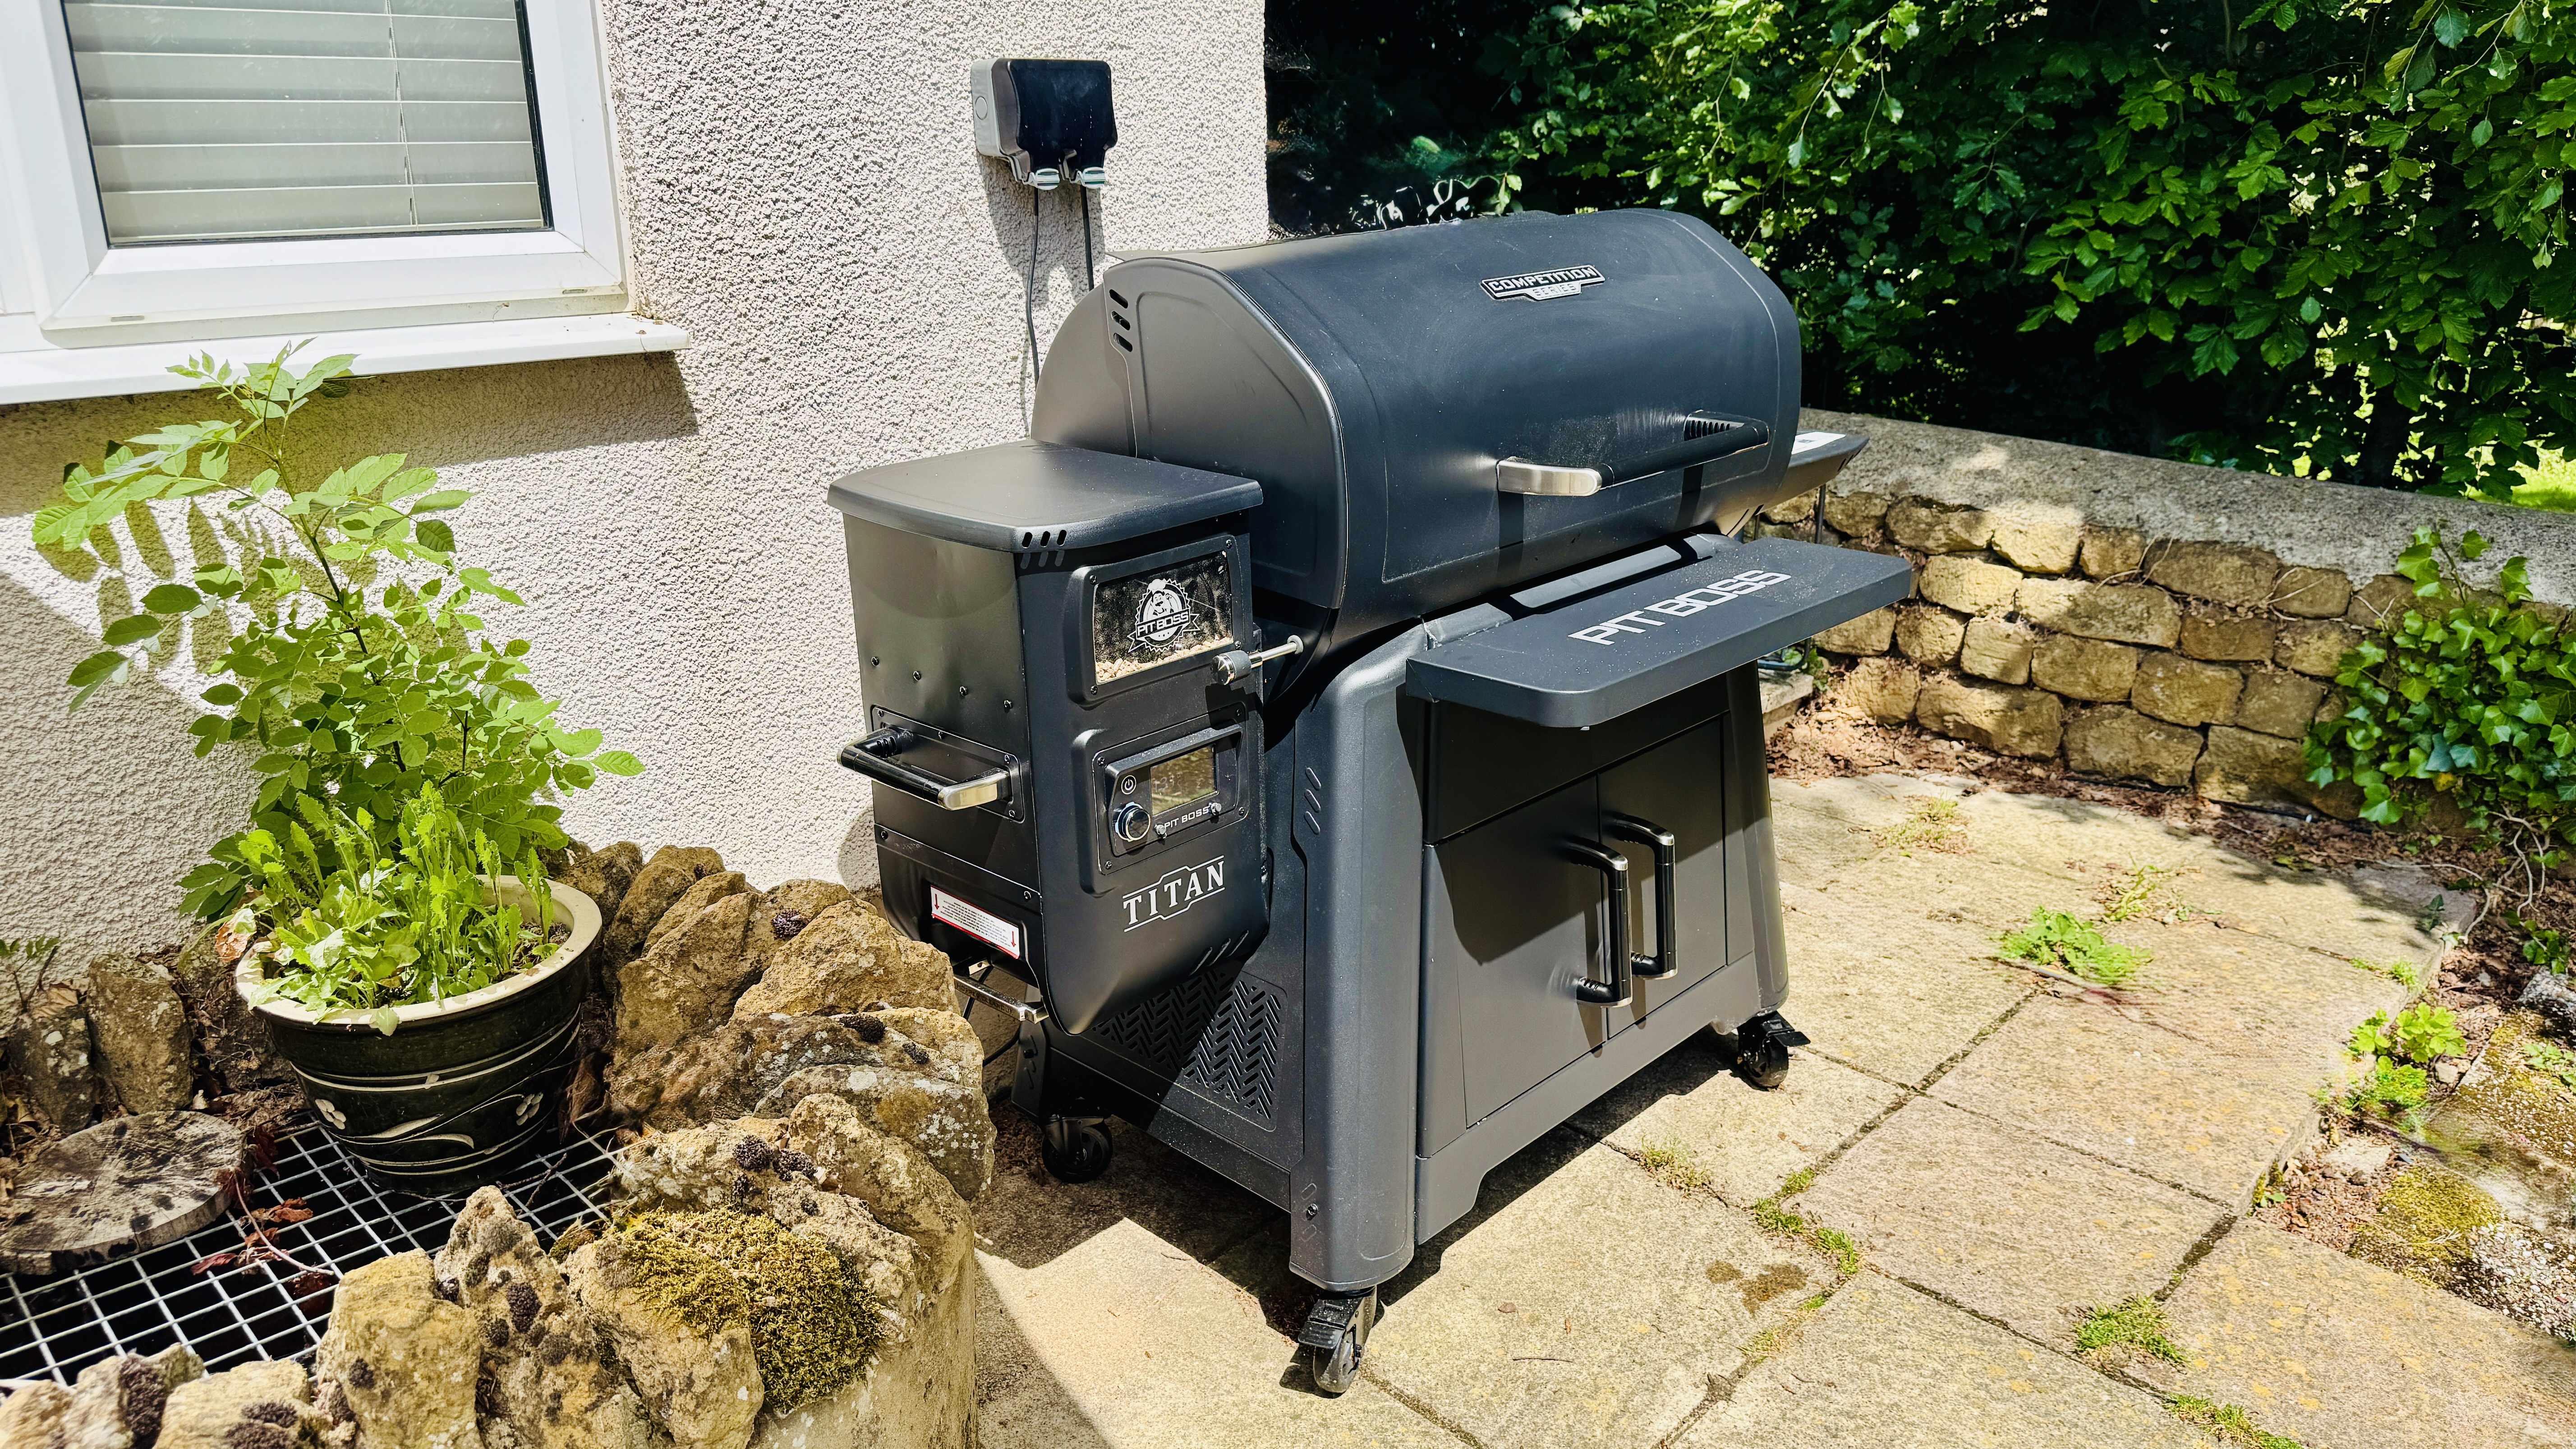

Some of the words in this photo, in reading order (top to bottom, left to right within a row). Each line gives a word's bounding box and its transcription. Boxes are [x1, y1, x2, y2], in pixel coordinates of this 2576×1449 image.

[1488, 267, 1597, 291] COMPETITION
[1532, 283, 1577, 296] SERIES
[1567, 610, 1665, 646] PIT
[1644, 570, 1791, 617] BOSS
[1137, 621, 1156, 636] PIT
[1156, 611, 1189, 630] BOSS
[1164, 818, 1179, 828] PIT
[1181, 806, 1210, 823] BOSS
[1123, 860, 1224, 925] TITAN
